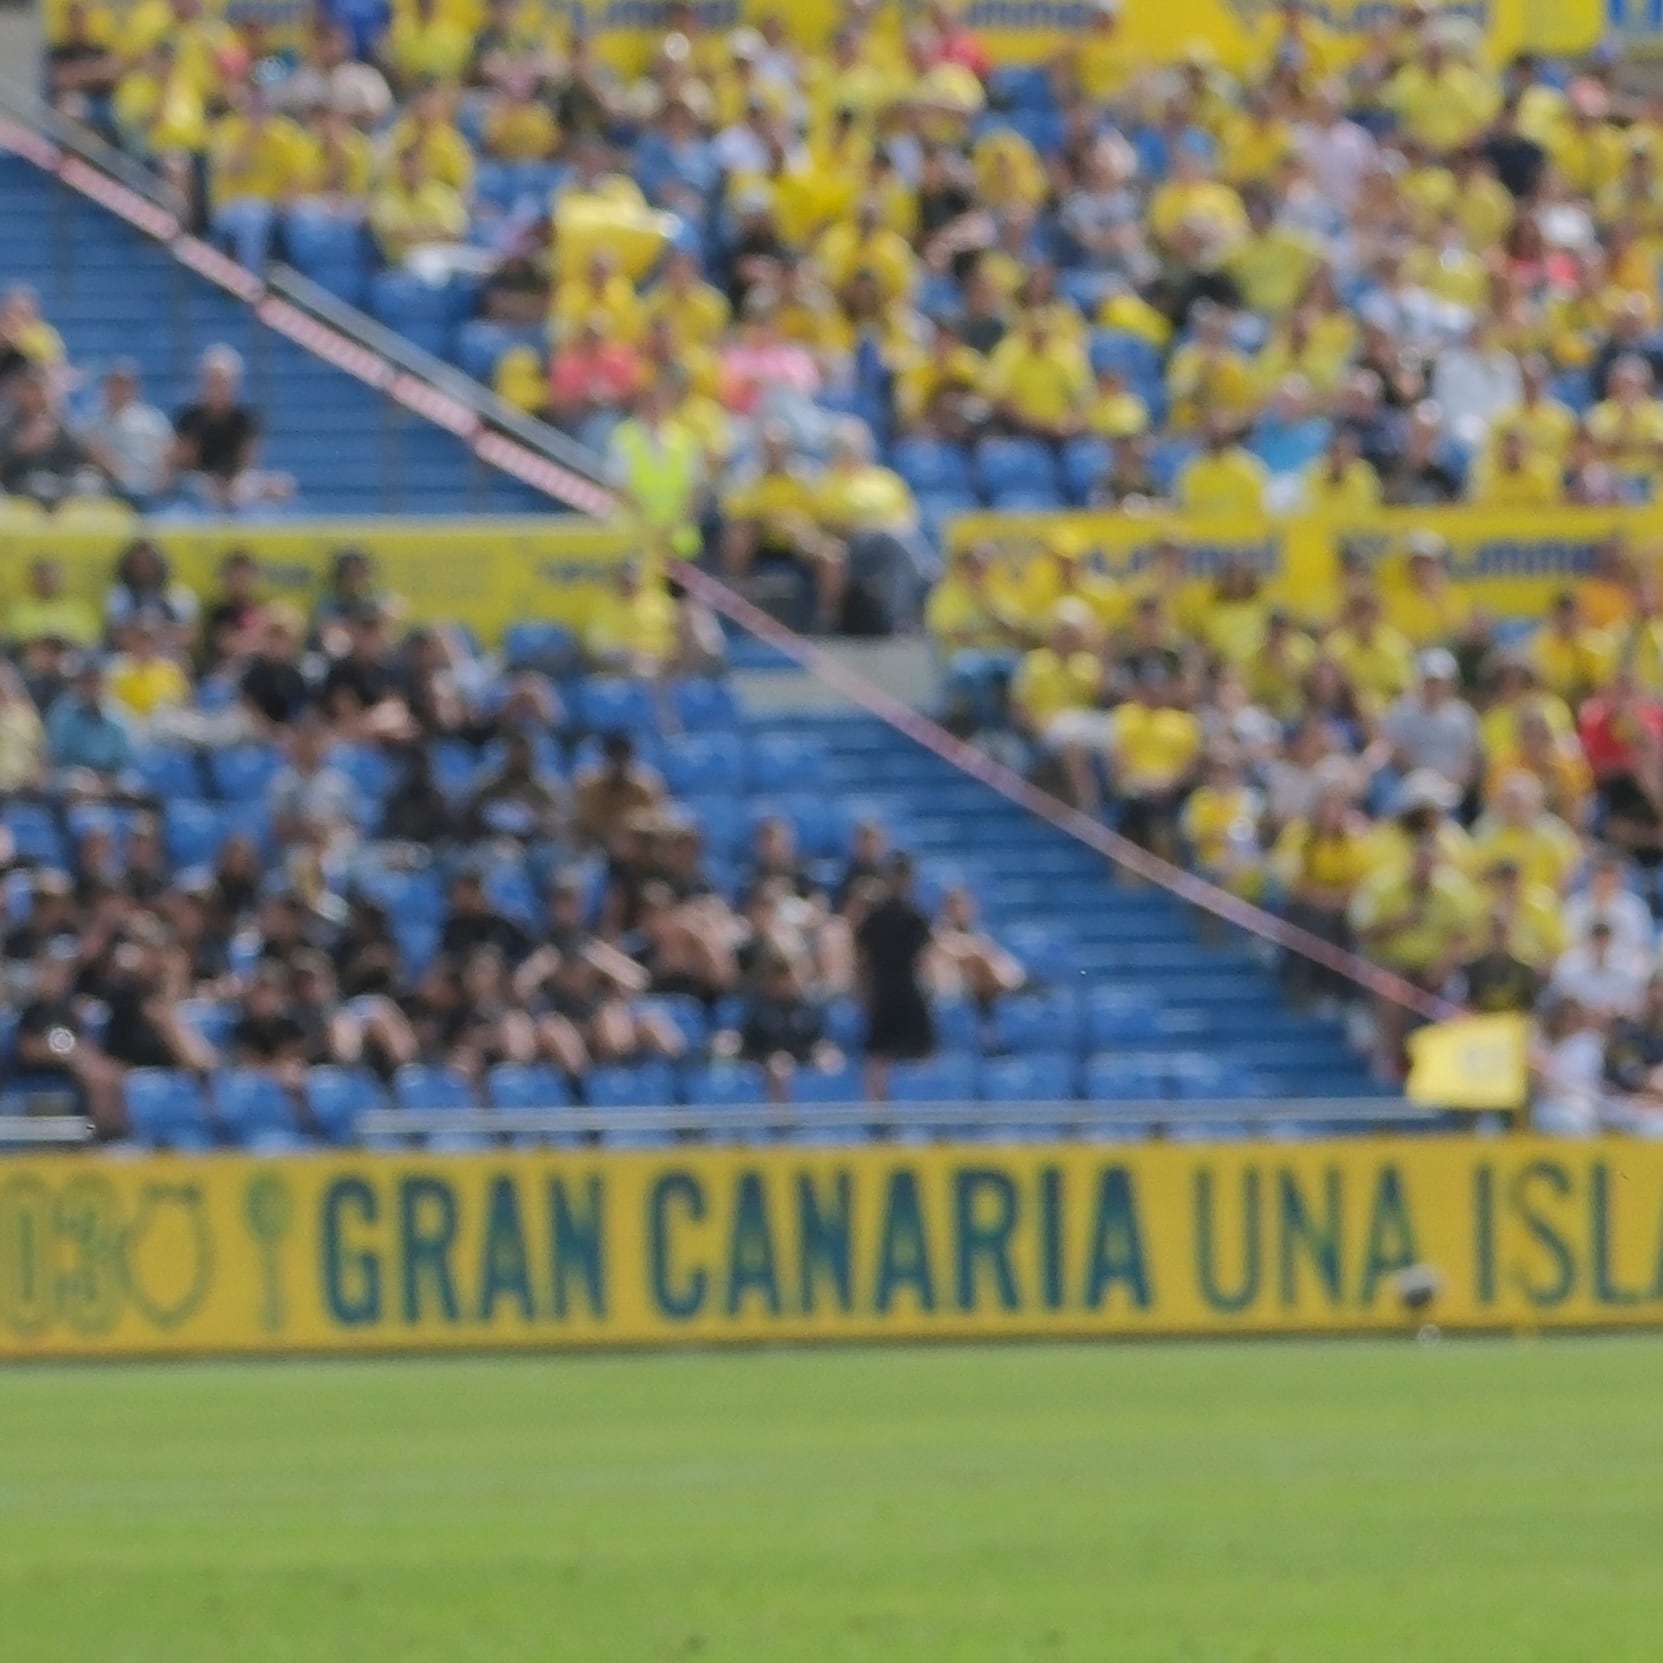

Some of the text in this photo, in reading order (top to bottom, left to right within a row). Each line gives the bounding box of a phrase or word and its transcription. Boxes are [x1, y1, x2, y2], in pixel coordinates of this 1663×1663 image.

[321, 1173, 604, 1326] GRAN
[646, 1168, 1153, 1320] CANARIA
[1196, 1160, 1426, 1313] UNA
